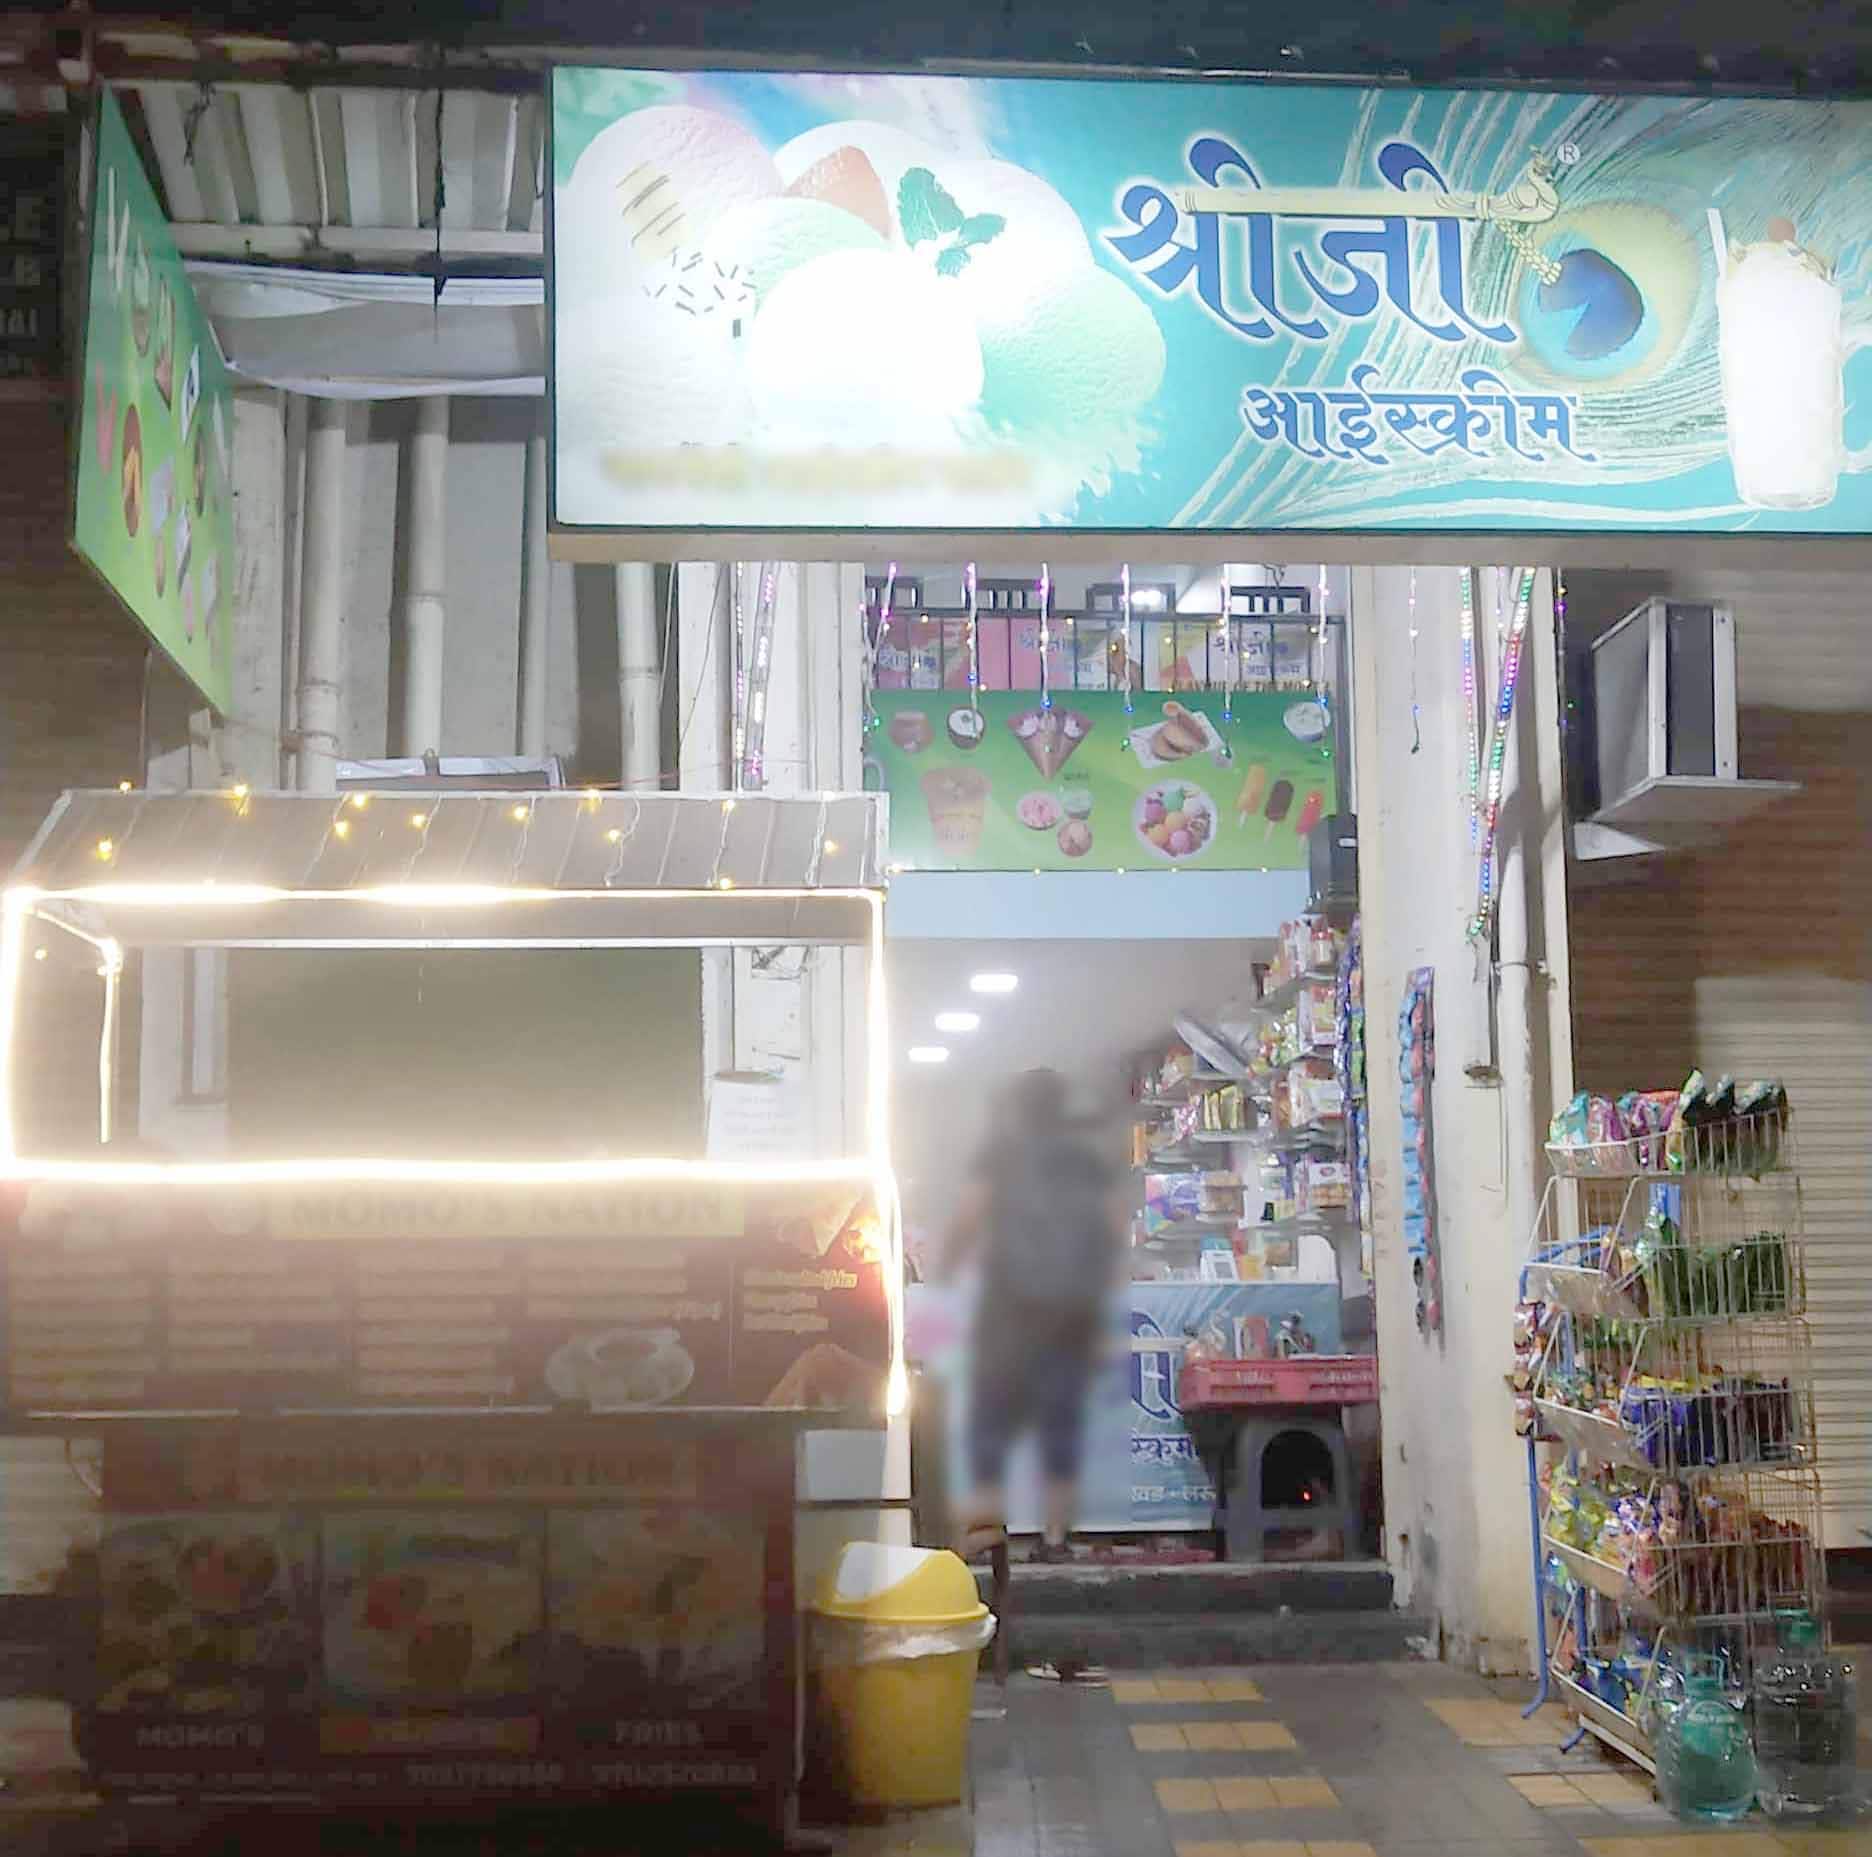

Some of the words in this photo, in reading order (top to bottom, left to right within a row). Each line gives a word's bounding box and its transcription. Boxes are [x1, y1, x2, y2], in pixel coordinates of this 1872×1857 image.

[1104, 138, 1518, 342] श्रीजी
[1244, 364, 1598, 465] आईस्क्रीम
[530, 1190, 722, 1227] NATION
